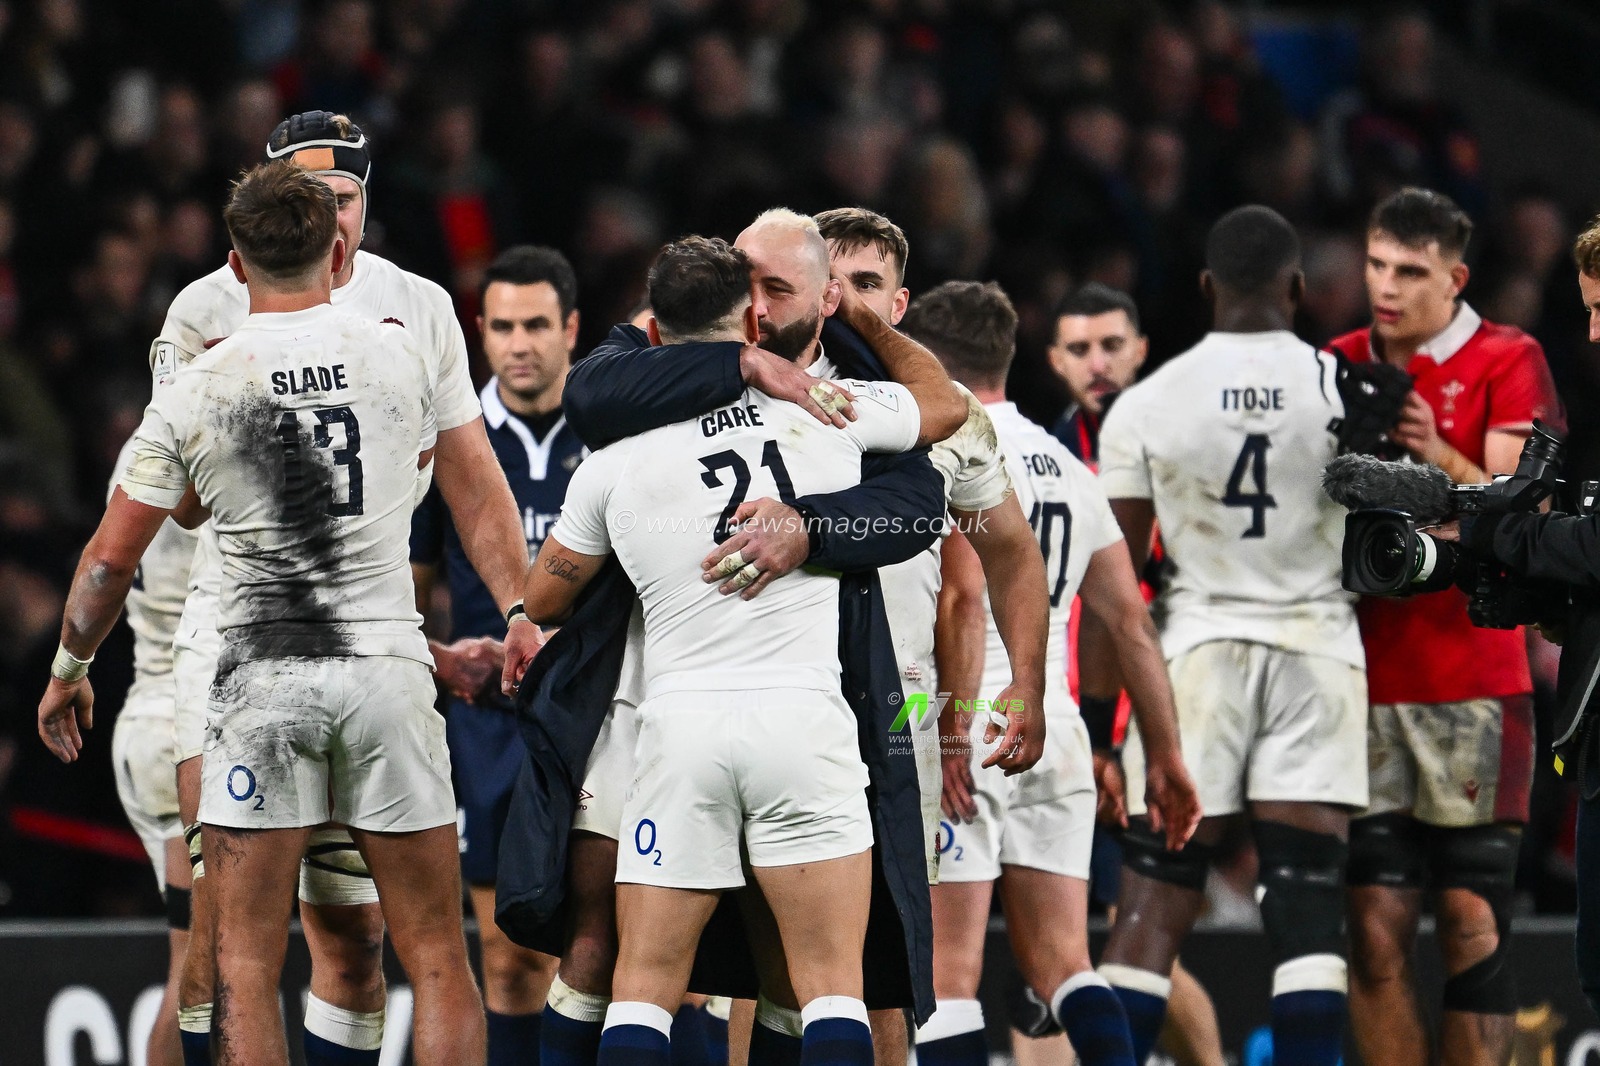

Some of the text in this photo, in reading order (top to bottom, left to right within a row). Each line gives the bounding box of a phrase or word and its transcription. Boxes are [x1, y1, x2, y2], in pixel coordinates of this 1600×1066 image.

[271, 364, 349, 396] SLADE
[1222, 387, 1286, 411] ITOJE
[701, 404, 764, 438] CARE
[276, 406, 364, 524] 13
[697, 439, 797, 546] 21
[1221, 433, 1278, 539] 4
[1028, 501, 1073, 608] 0
[635, 818, 662, 866] O2
